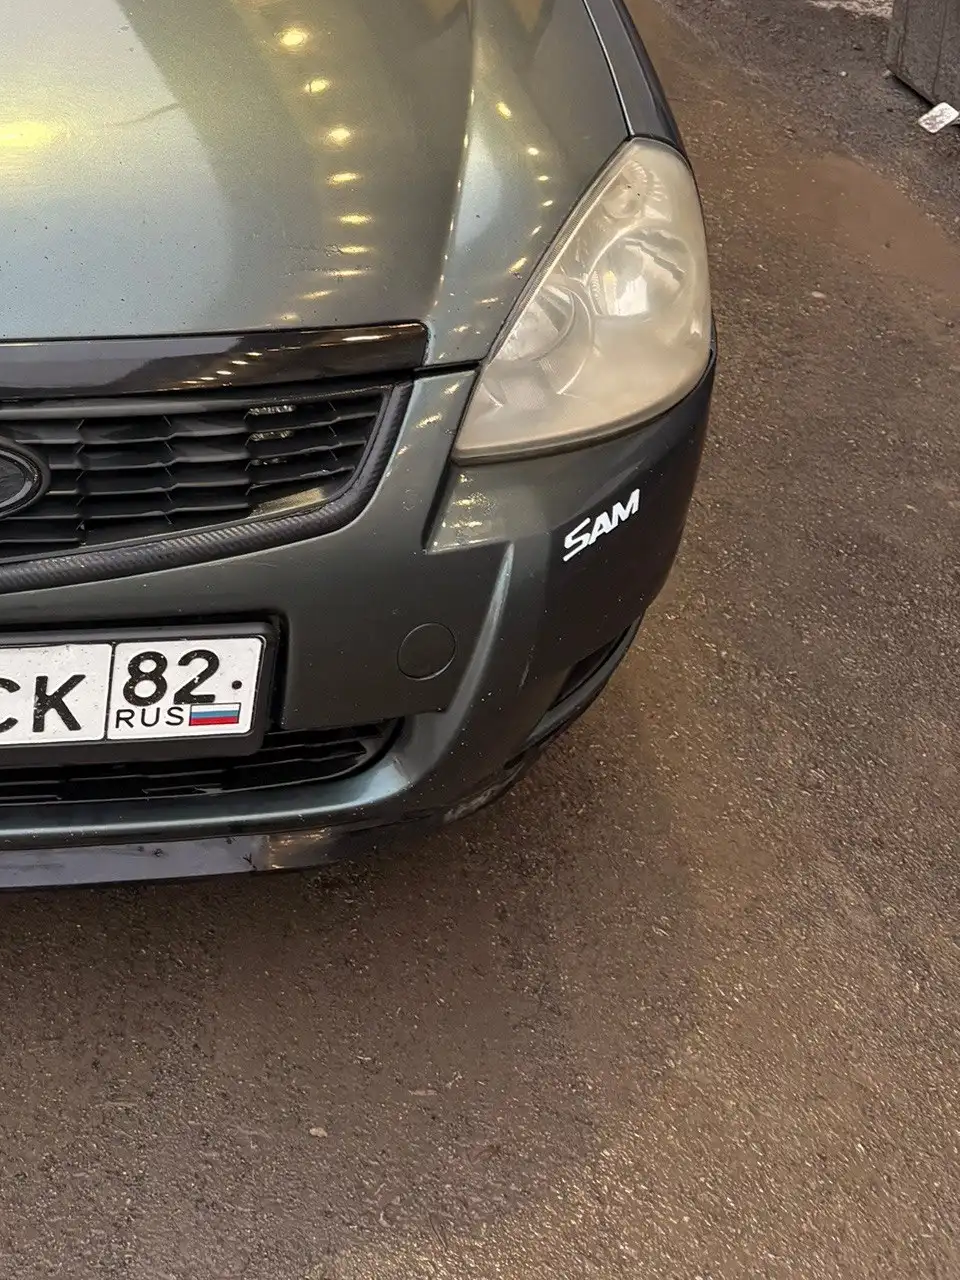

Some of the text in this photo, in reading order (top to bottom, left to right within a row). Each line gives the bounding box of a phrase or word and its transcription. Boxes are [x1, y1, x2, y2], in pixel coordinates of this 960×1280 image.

[563, 488, 640, 561] SAM
[123, 649, 220, 707] 82
[115, 706, 184, 729] RUS
